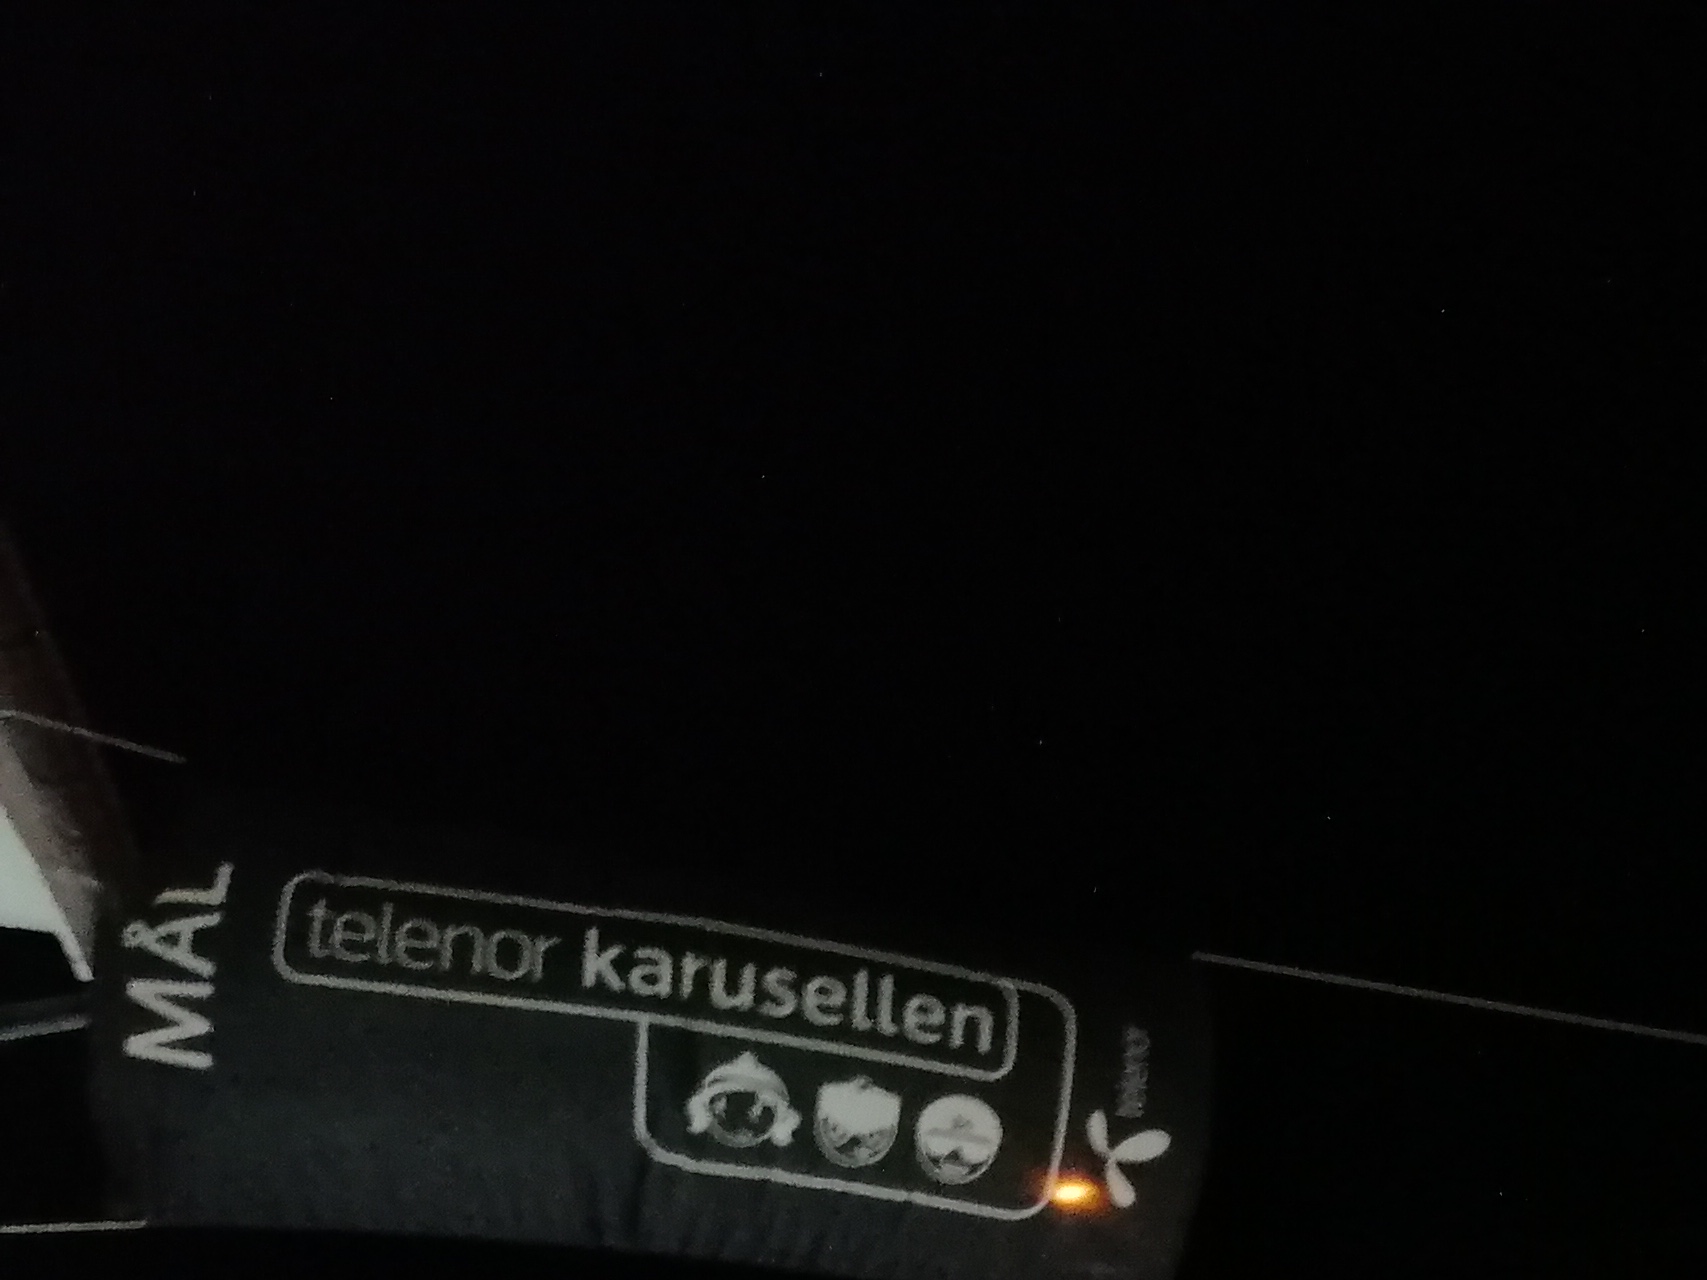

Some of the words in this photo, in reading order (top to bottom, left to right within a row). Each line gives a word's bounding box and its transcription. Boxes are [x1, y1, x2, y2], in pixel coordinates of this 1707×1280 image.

[121, 860, 235, 1070] MÅL
[307, 899, 562, 983] telenor
[580, 926, 995, 1054] karusellen
